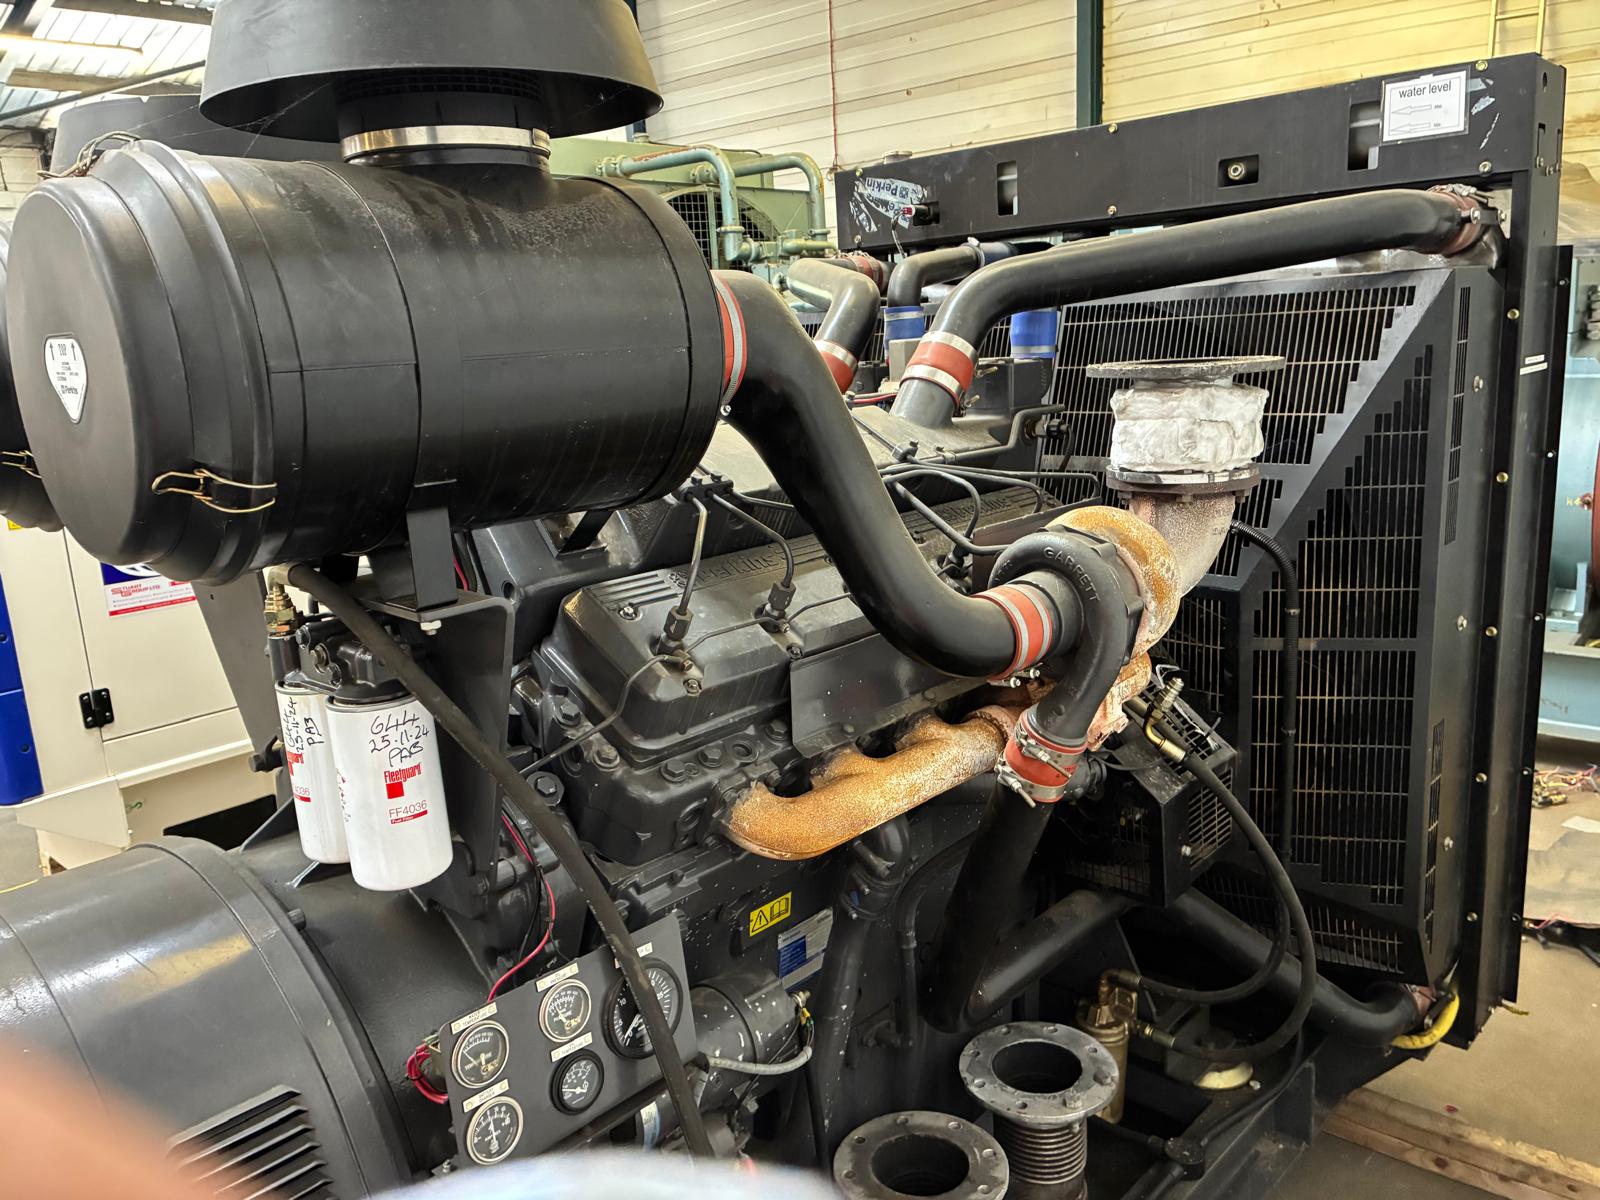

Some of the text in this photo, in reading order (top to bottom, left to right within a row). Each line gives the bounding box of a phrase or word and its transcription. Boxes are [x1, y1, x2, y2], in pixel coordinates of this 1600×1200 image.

[1399, 80, 1452, 99] water level
[1044, 546, 1101, 602] GARRETT
[384, 763, 421, 783] Fleetguard
[389, 800, 427, 819] FF4036
